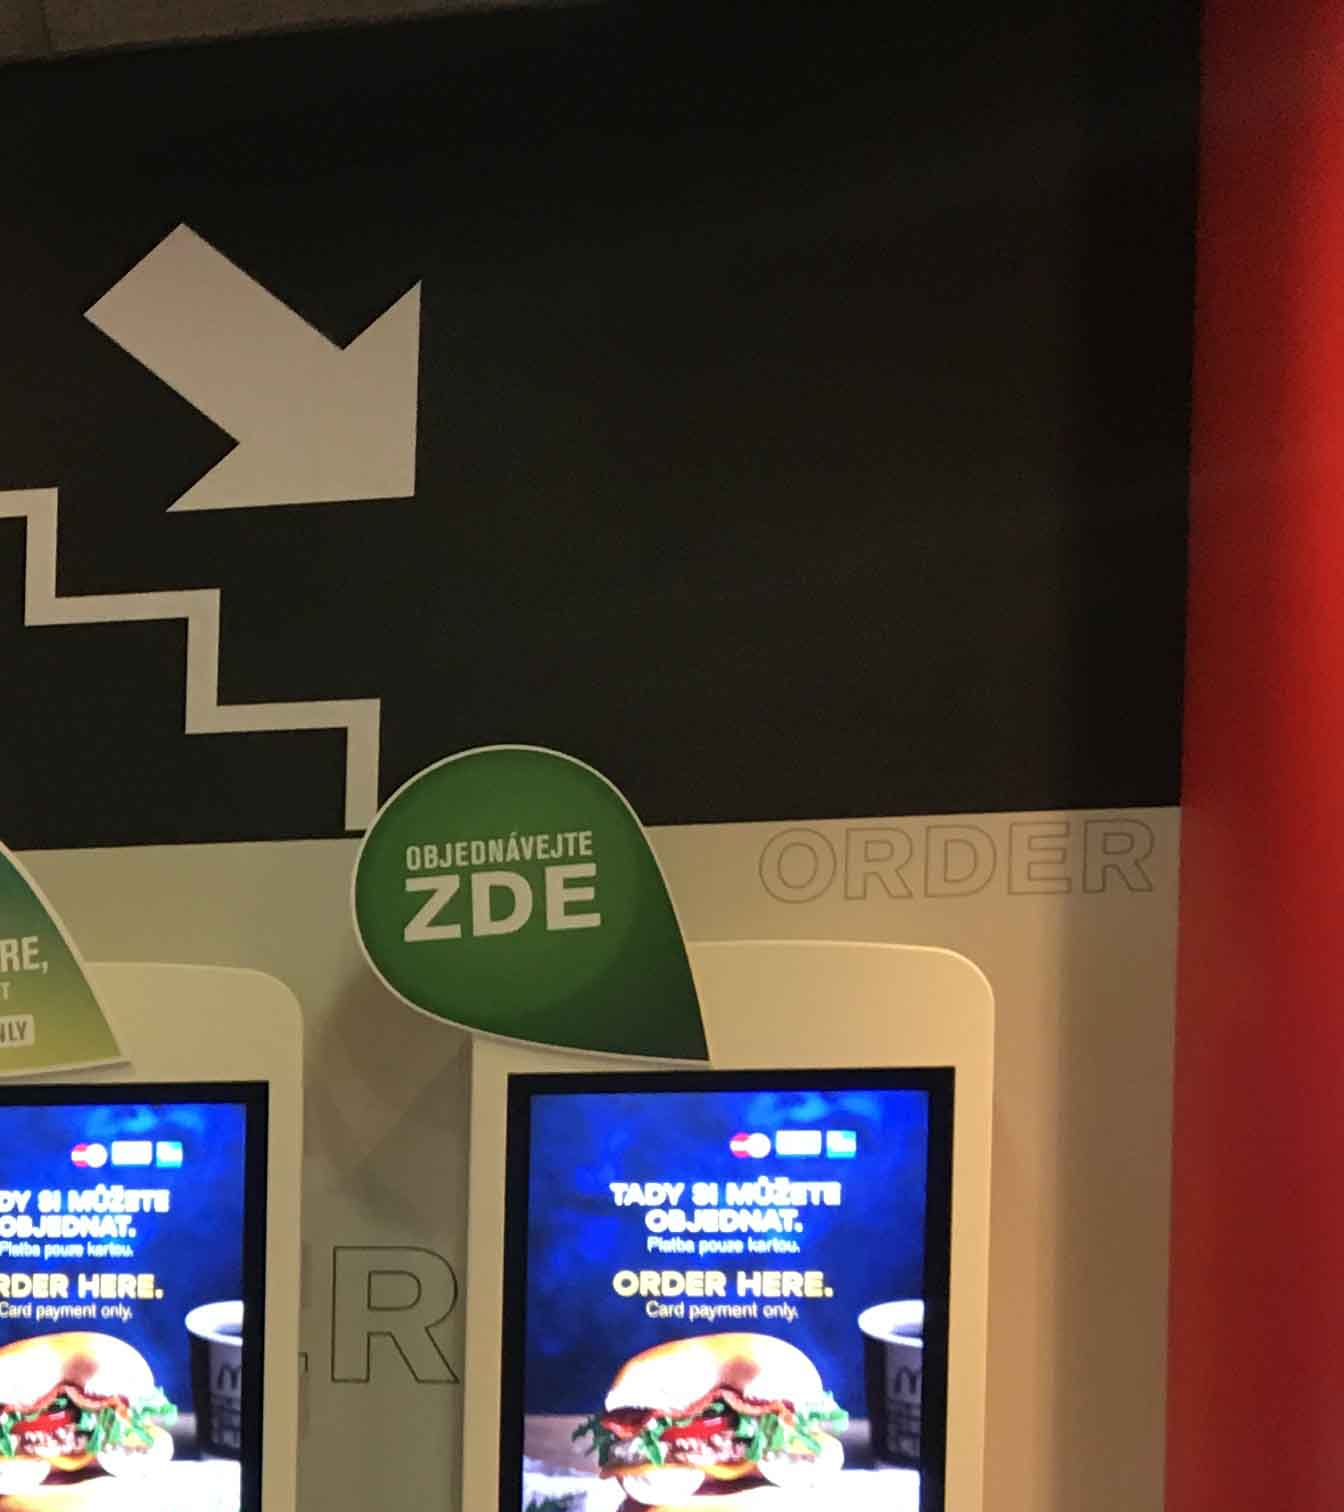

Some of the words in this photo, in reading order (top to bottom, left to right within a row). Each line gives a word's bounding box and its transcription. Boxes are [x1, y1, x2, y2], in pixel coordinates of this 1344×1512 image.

[406, 830, 593, 872] OBJEDNÁVEJTE
[759, 818, 1155, 905] ORDER
[403, 862, 601, 943] ZDE
[37, 1190, 61, 1213] SI
[610, 1182, 684, 1207] TADY
[691, 1182, 719, 1207] SI
[645, 1208, 804, 1233] OBJEDNAT.
[44, 1243, 84, 1260] pouze
[646, 1237, 695, 1253] Platba
[699, 1239, 743, 1256] pouze
[78, 1273, 164, 1299] HERE.
[612, 1271, 726, 1297] ORDER
[736, 1271, 833, 1297] HERE.
[36, 1303, 97, 1321] payment
[101, 1303, 133, 1322] only.
[645, 1301, 684, 1319] Card
[689, 1303, 757, 1322] payment
[763, 1301, 799, 1323] only.
